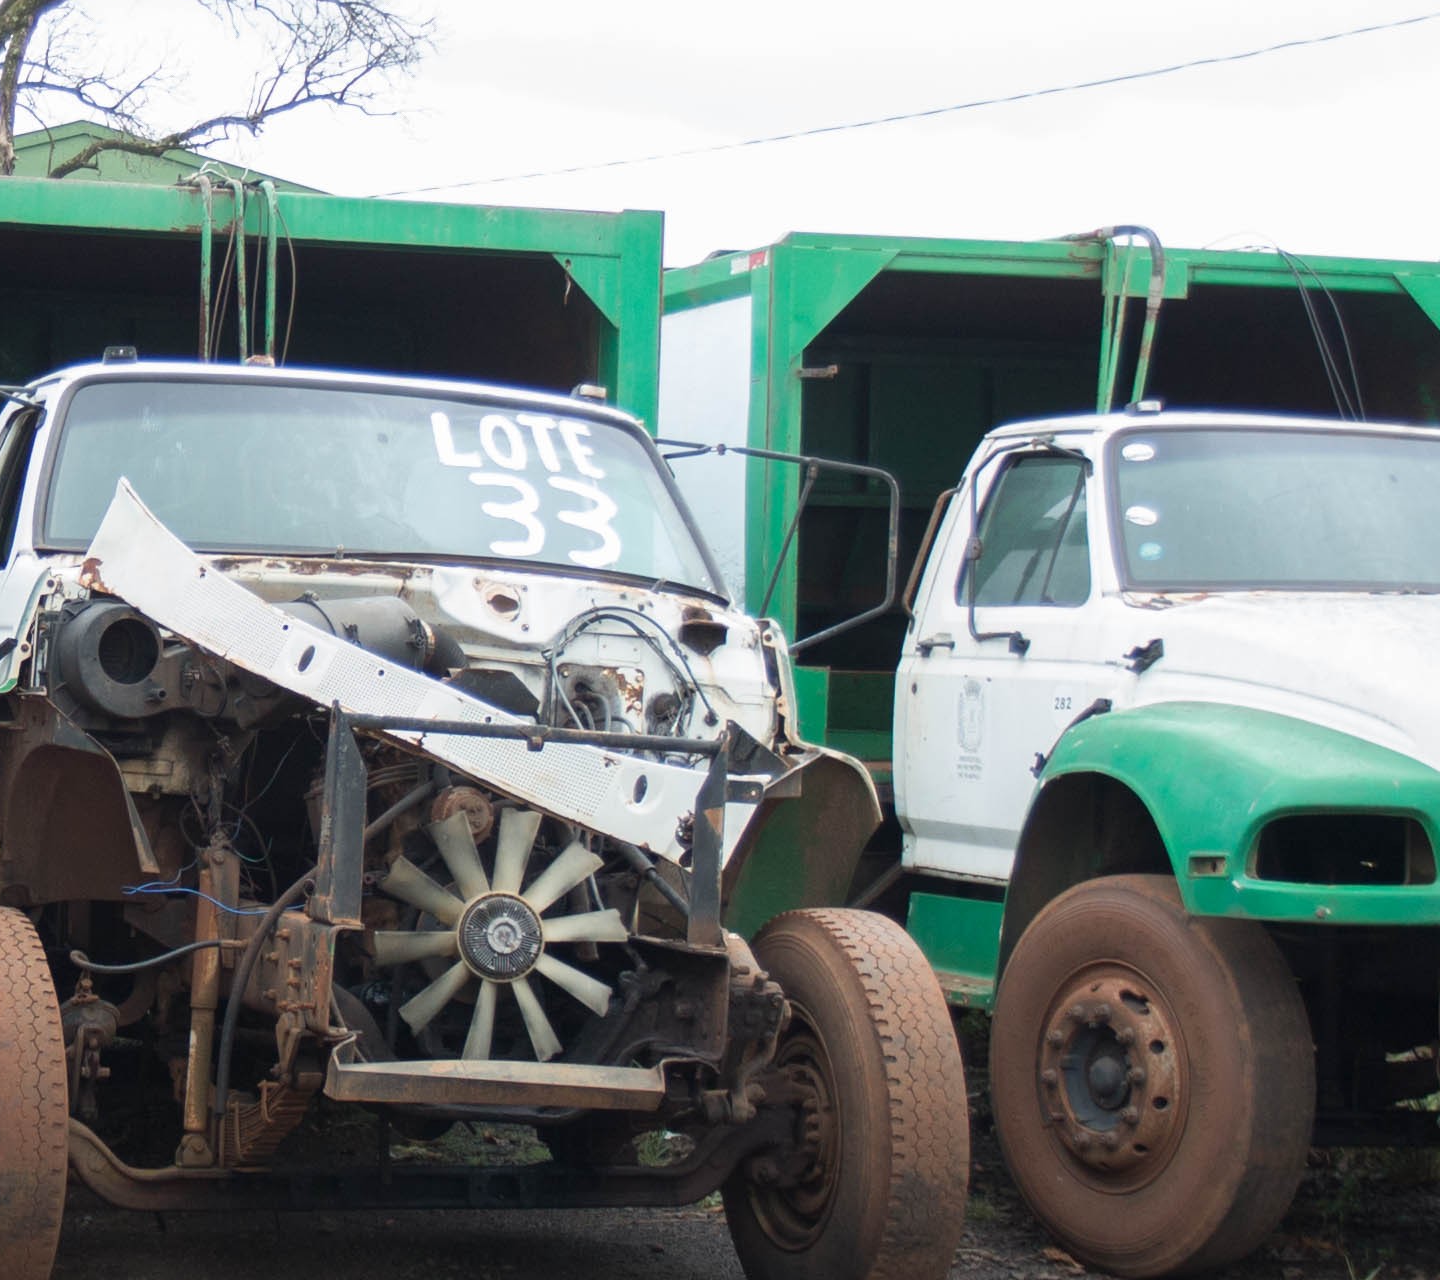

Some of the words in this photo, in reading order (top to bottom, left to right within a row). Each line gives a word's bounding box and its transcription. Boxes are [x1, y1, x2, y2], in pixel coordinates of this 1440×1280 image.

[430, 411, 606, 479] LOTE
[468, 472, 622, 568] 33
[1054, 697, 1072, 710] 282
